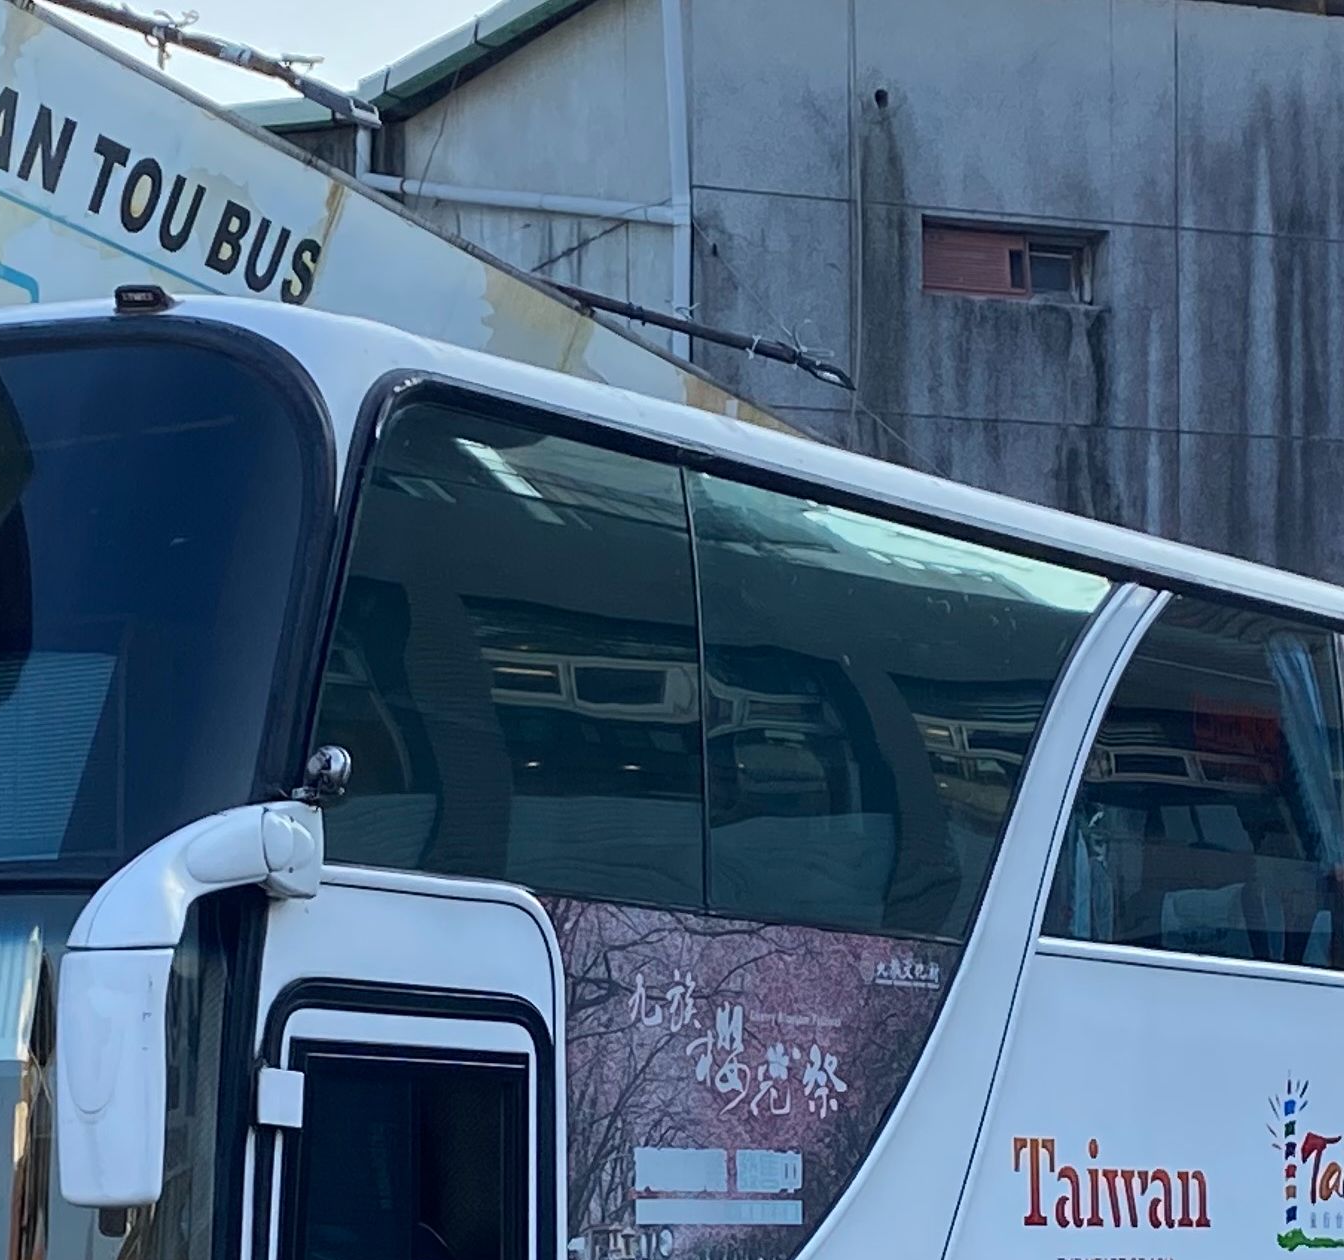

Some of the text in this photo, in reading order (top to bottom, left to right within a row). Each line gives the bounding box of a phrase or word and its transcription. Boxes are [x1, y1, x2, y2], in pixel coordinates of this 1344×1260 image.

[87, 133, 207, 254] TOU
[203, 199, 322, 306] BUS
[1013, 1137, 1212, 1229] Taiwan
